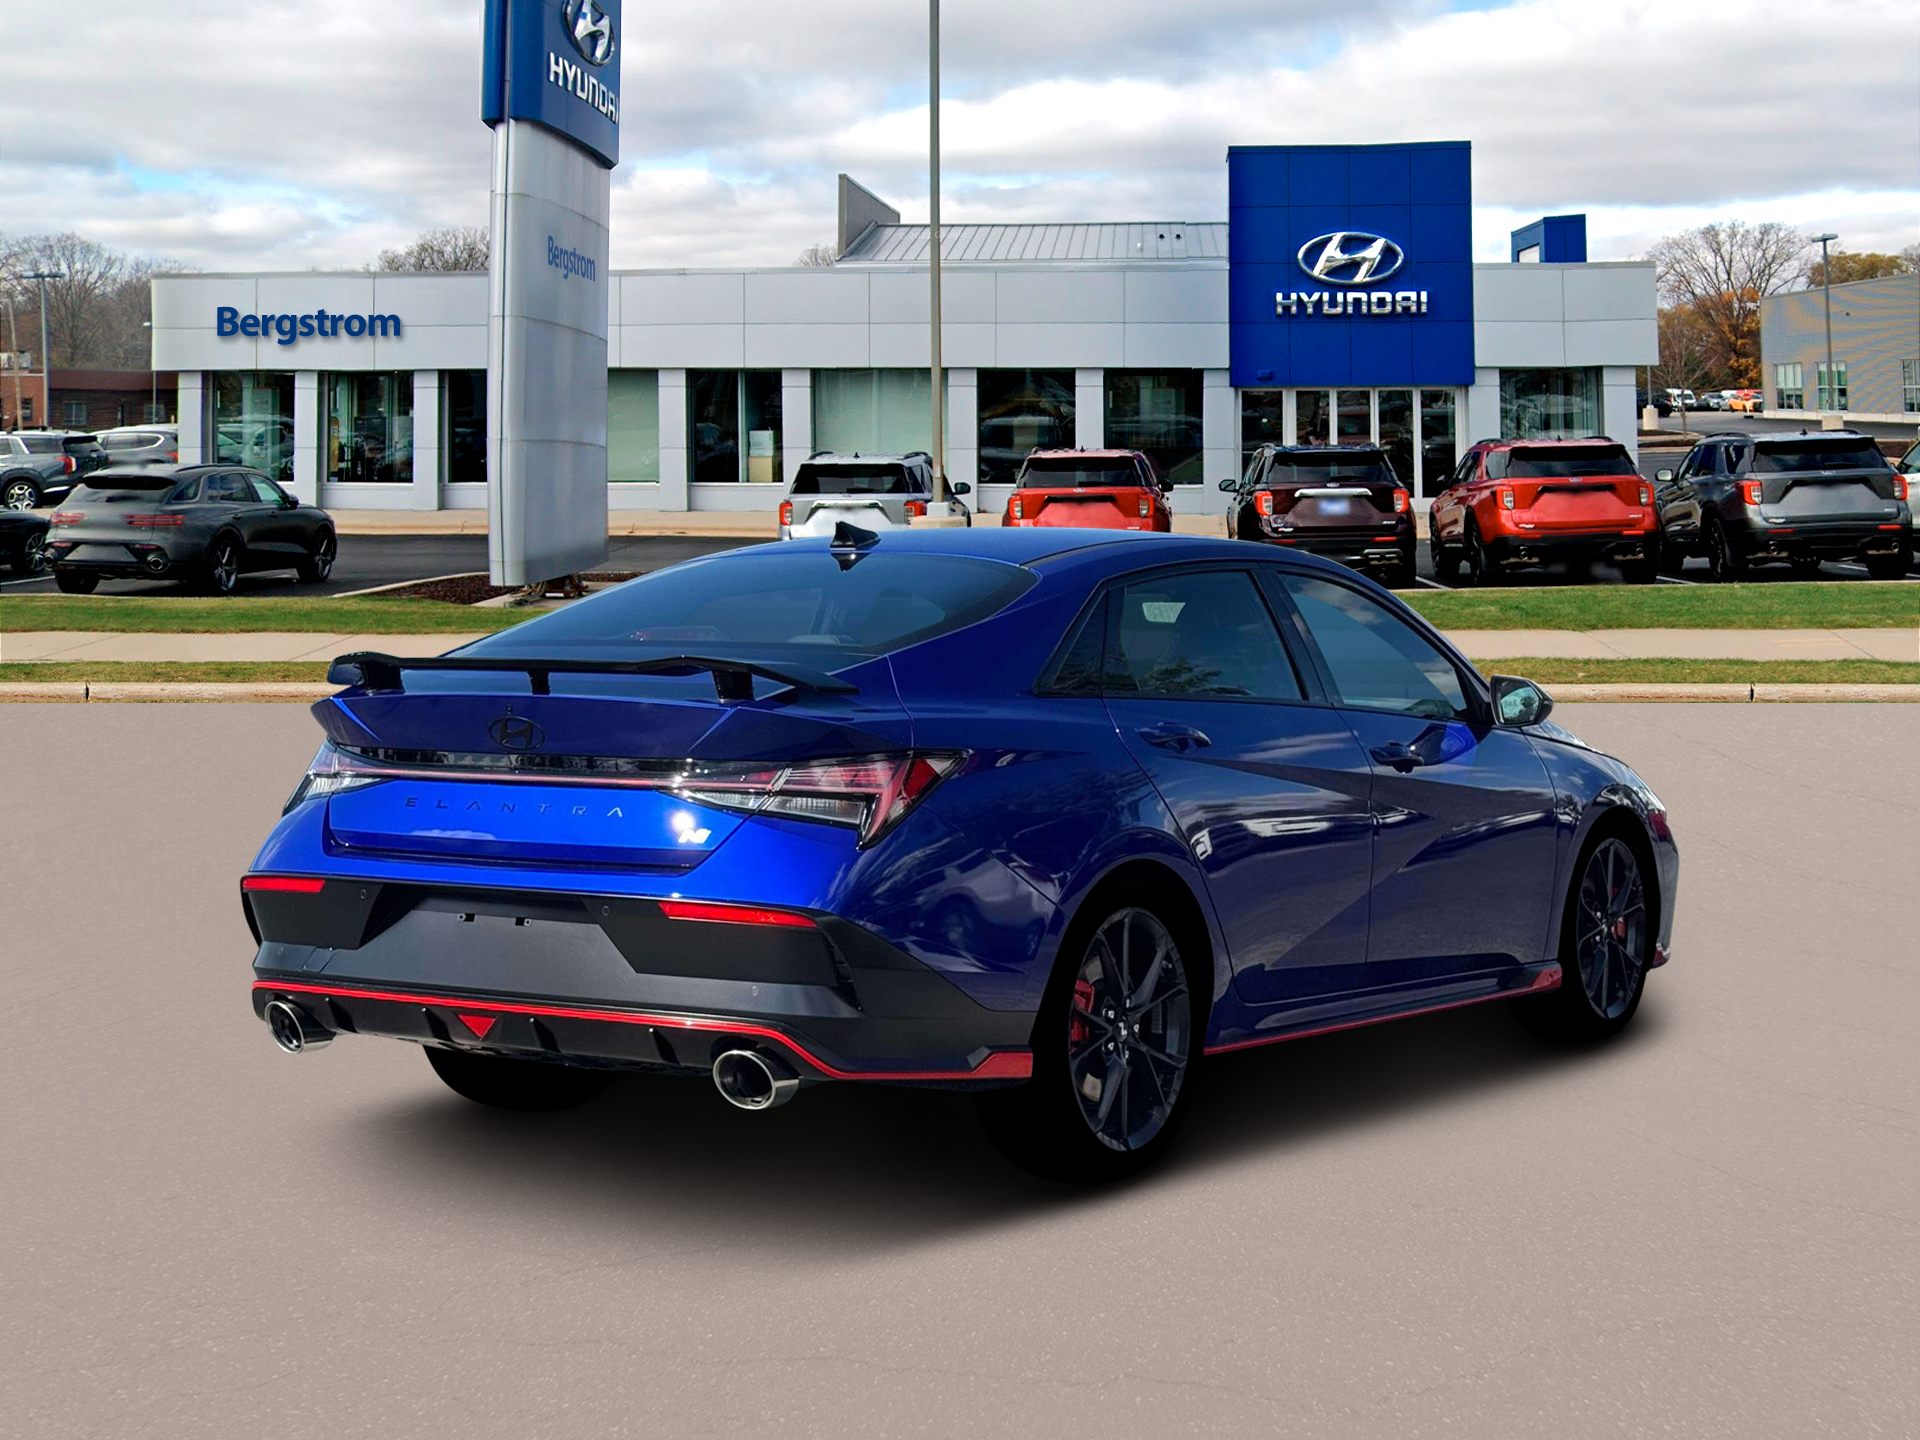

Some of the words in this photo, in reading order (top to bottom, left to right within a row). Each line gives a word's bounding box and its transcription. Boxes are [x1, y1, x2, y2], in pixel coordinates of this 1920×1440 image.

[549, 52, 618, 124] HYUNDAI
[548, 235, 595, 281] Bergstrom
[1275, 291, 1427, 314] HYUNDAI
[217, 306, 401, 345] Bergstrom
[405, 797, 623, 818] ELANTRA
